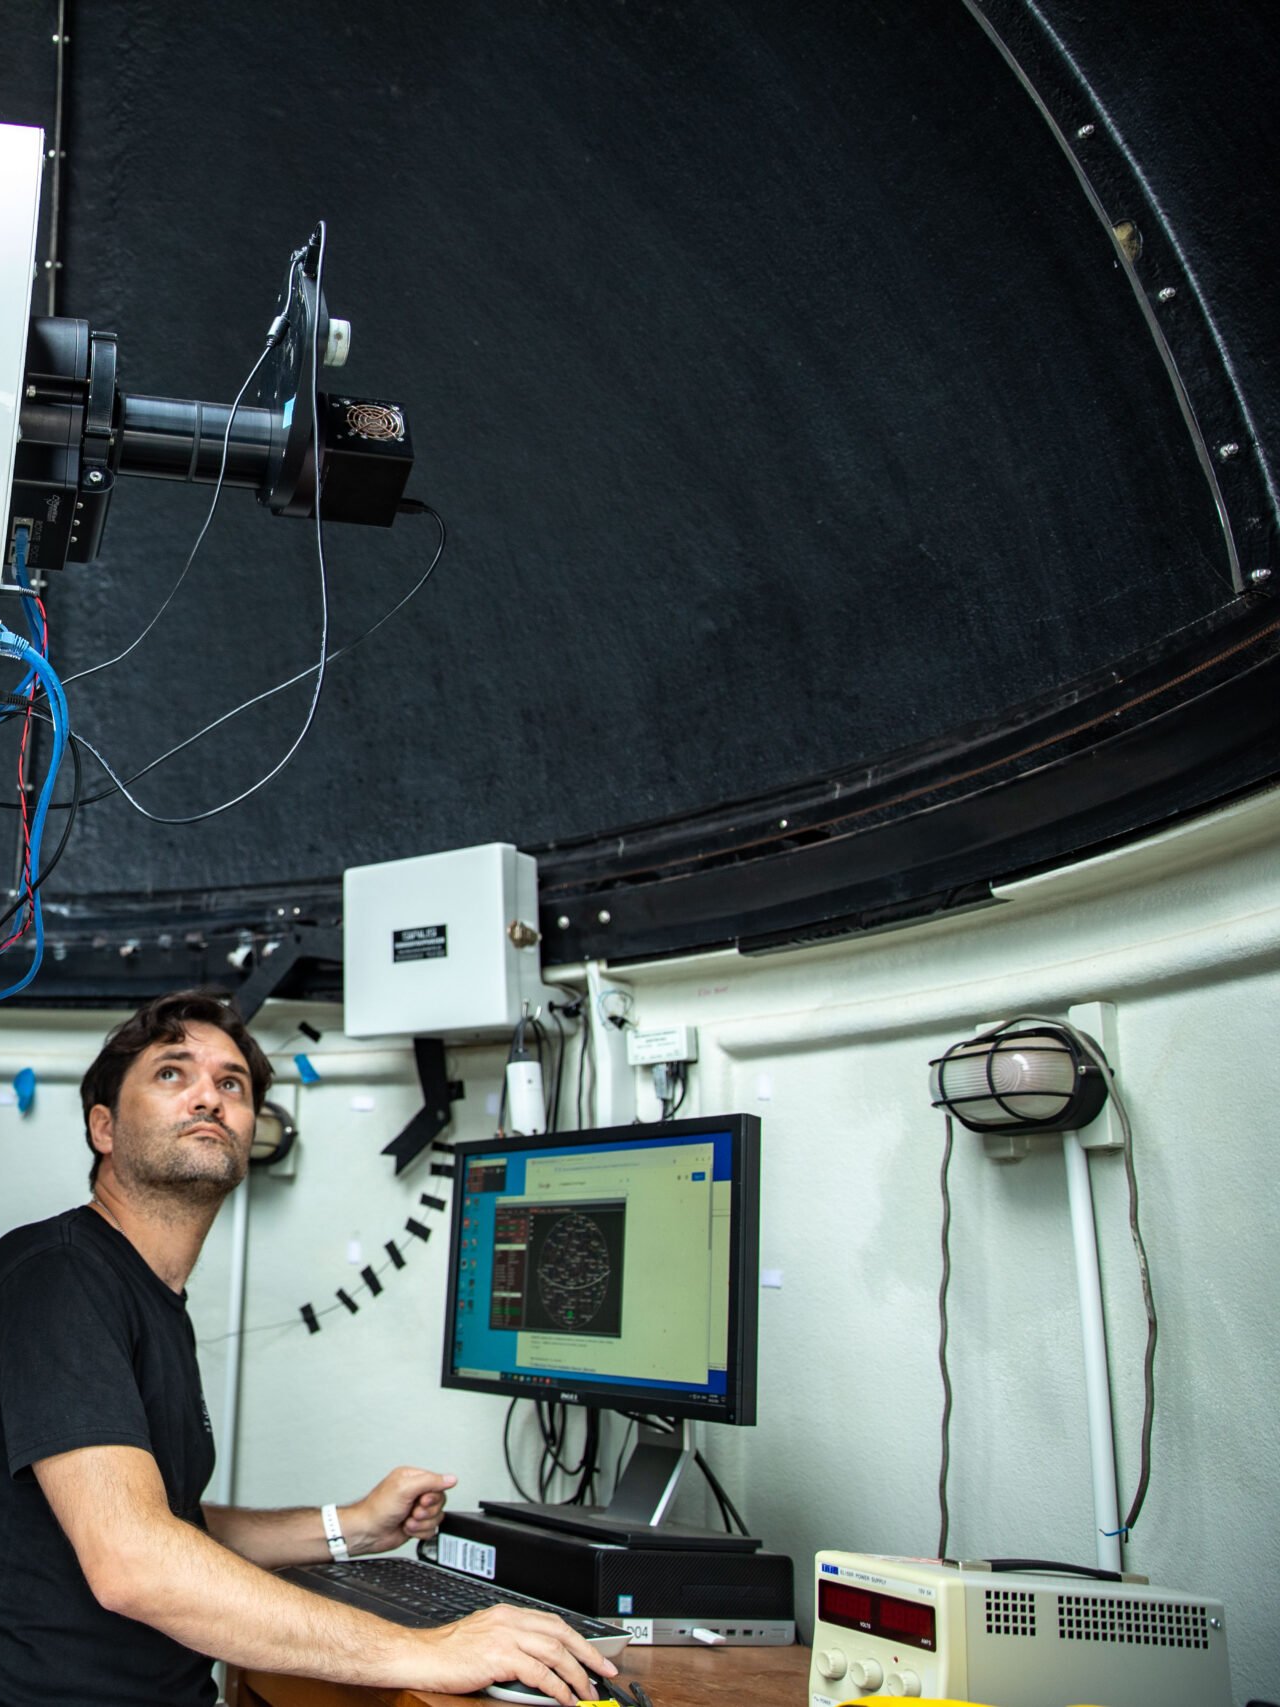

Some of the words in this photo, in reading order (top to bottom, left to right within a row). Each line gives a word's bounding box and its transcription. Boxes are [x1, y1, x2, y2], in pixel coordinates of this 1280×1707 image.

[855, 1573, 870, 1581] POWER
[871, 1576, 887, 1585] SUPPLY
[859, 1621, 871, 1629] VOLTS
[921, 1638, 932, 1646] AMPS
